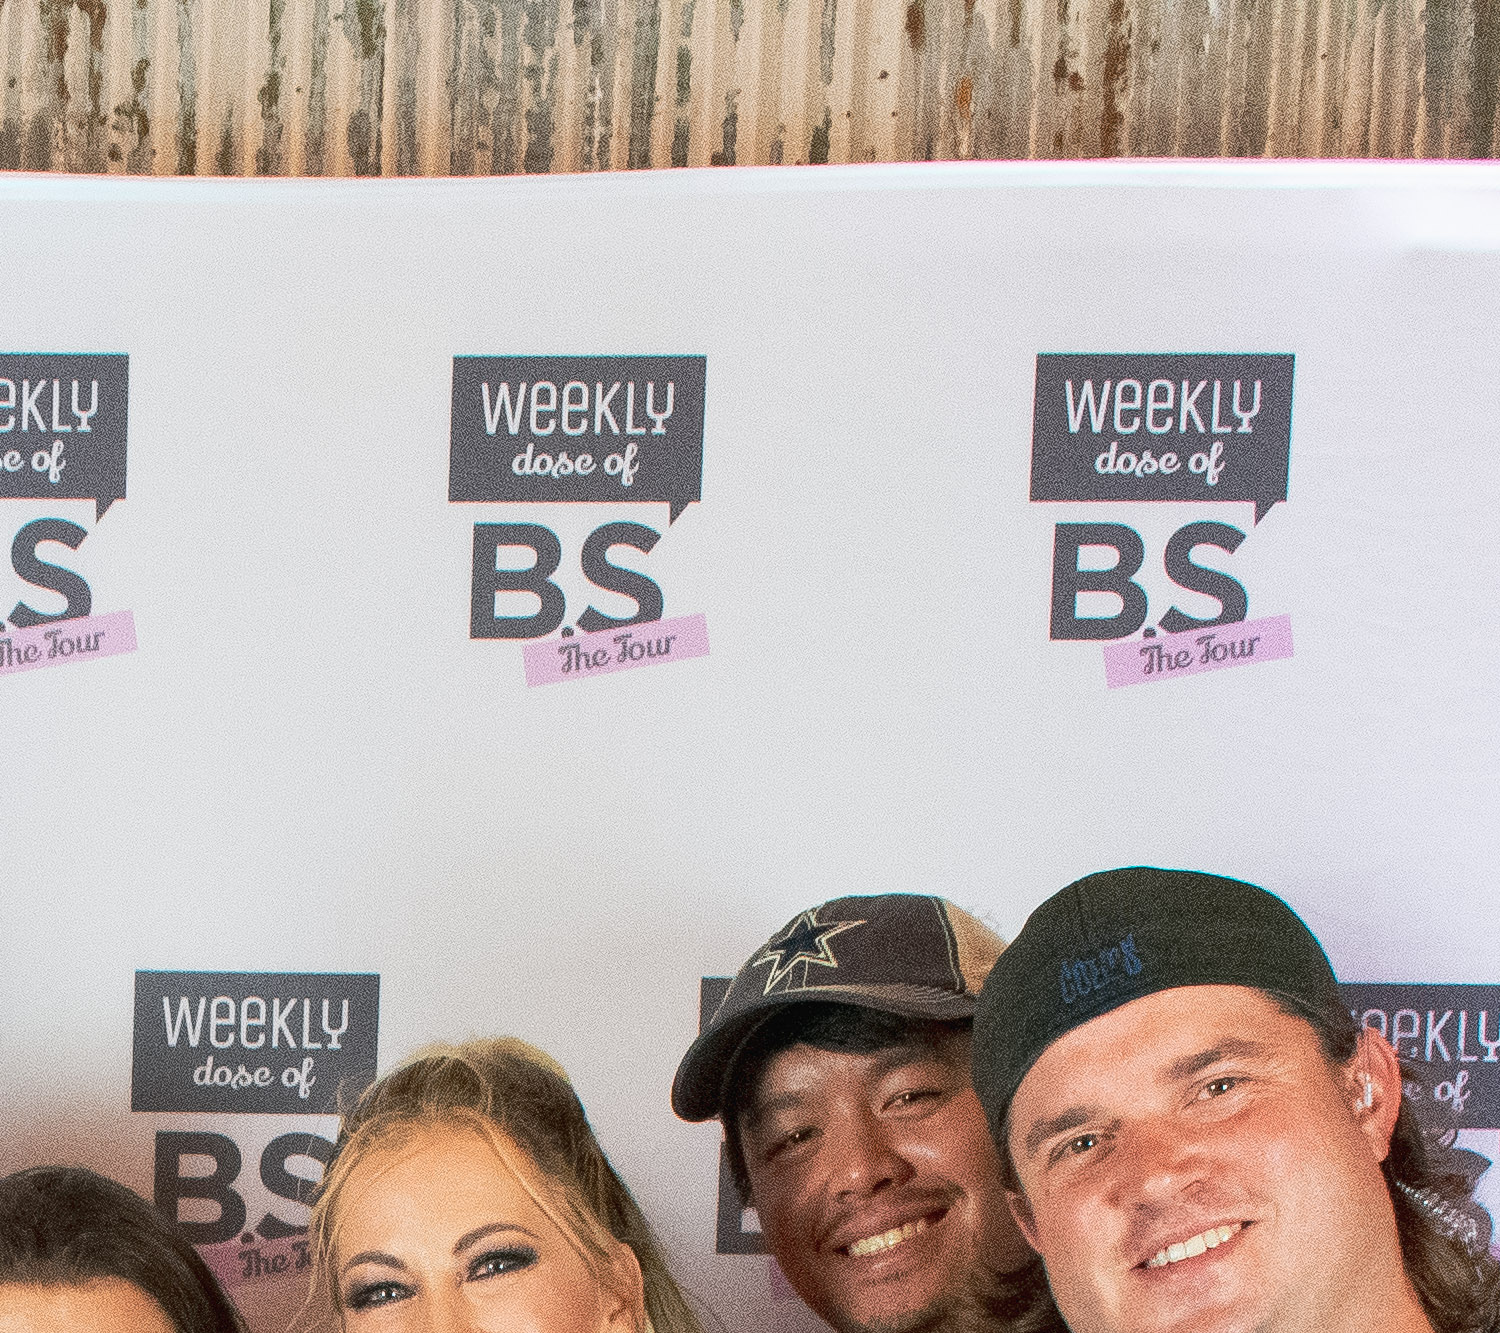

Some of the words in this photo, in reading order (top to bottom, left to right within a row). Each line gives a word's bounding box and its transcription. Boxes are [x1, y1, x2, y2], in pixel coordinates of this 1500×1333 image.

[31, 440, 66, 483] of
[512, 443, 596, 478] dose
[604, 443, 639, 486] of
[1094, 441, 1181, 477] dose
[1188, 441, 1225, 486] of
[44, 629, 106, 660] Tour
[558, 641, 611, 673] The
[613, 633, 677, 663] Tour
[1140, 642, 1194, 674] The
[1196, 634, 1260, 664] Tour
[193, 1056, 275, 1090] dose
[281, 1057, 316, 1099] of
[1434, 1070, 1471, 1113] of
